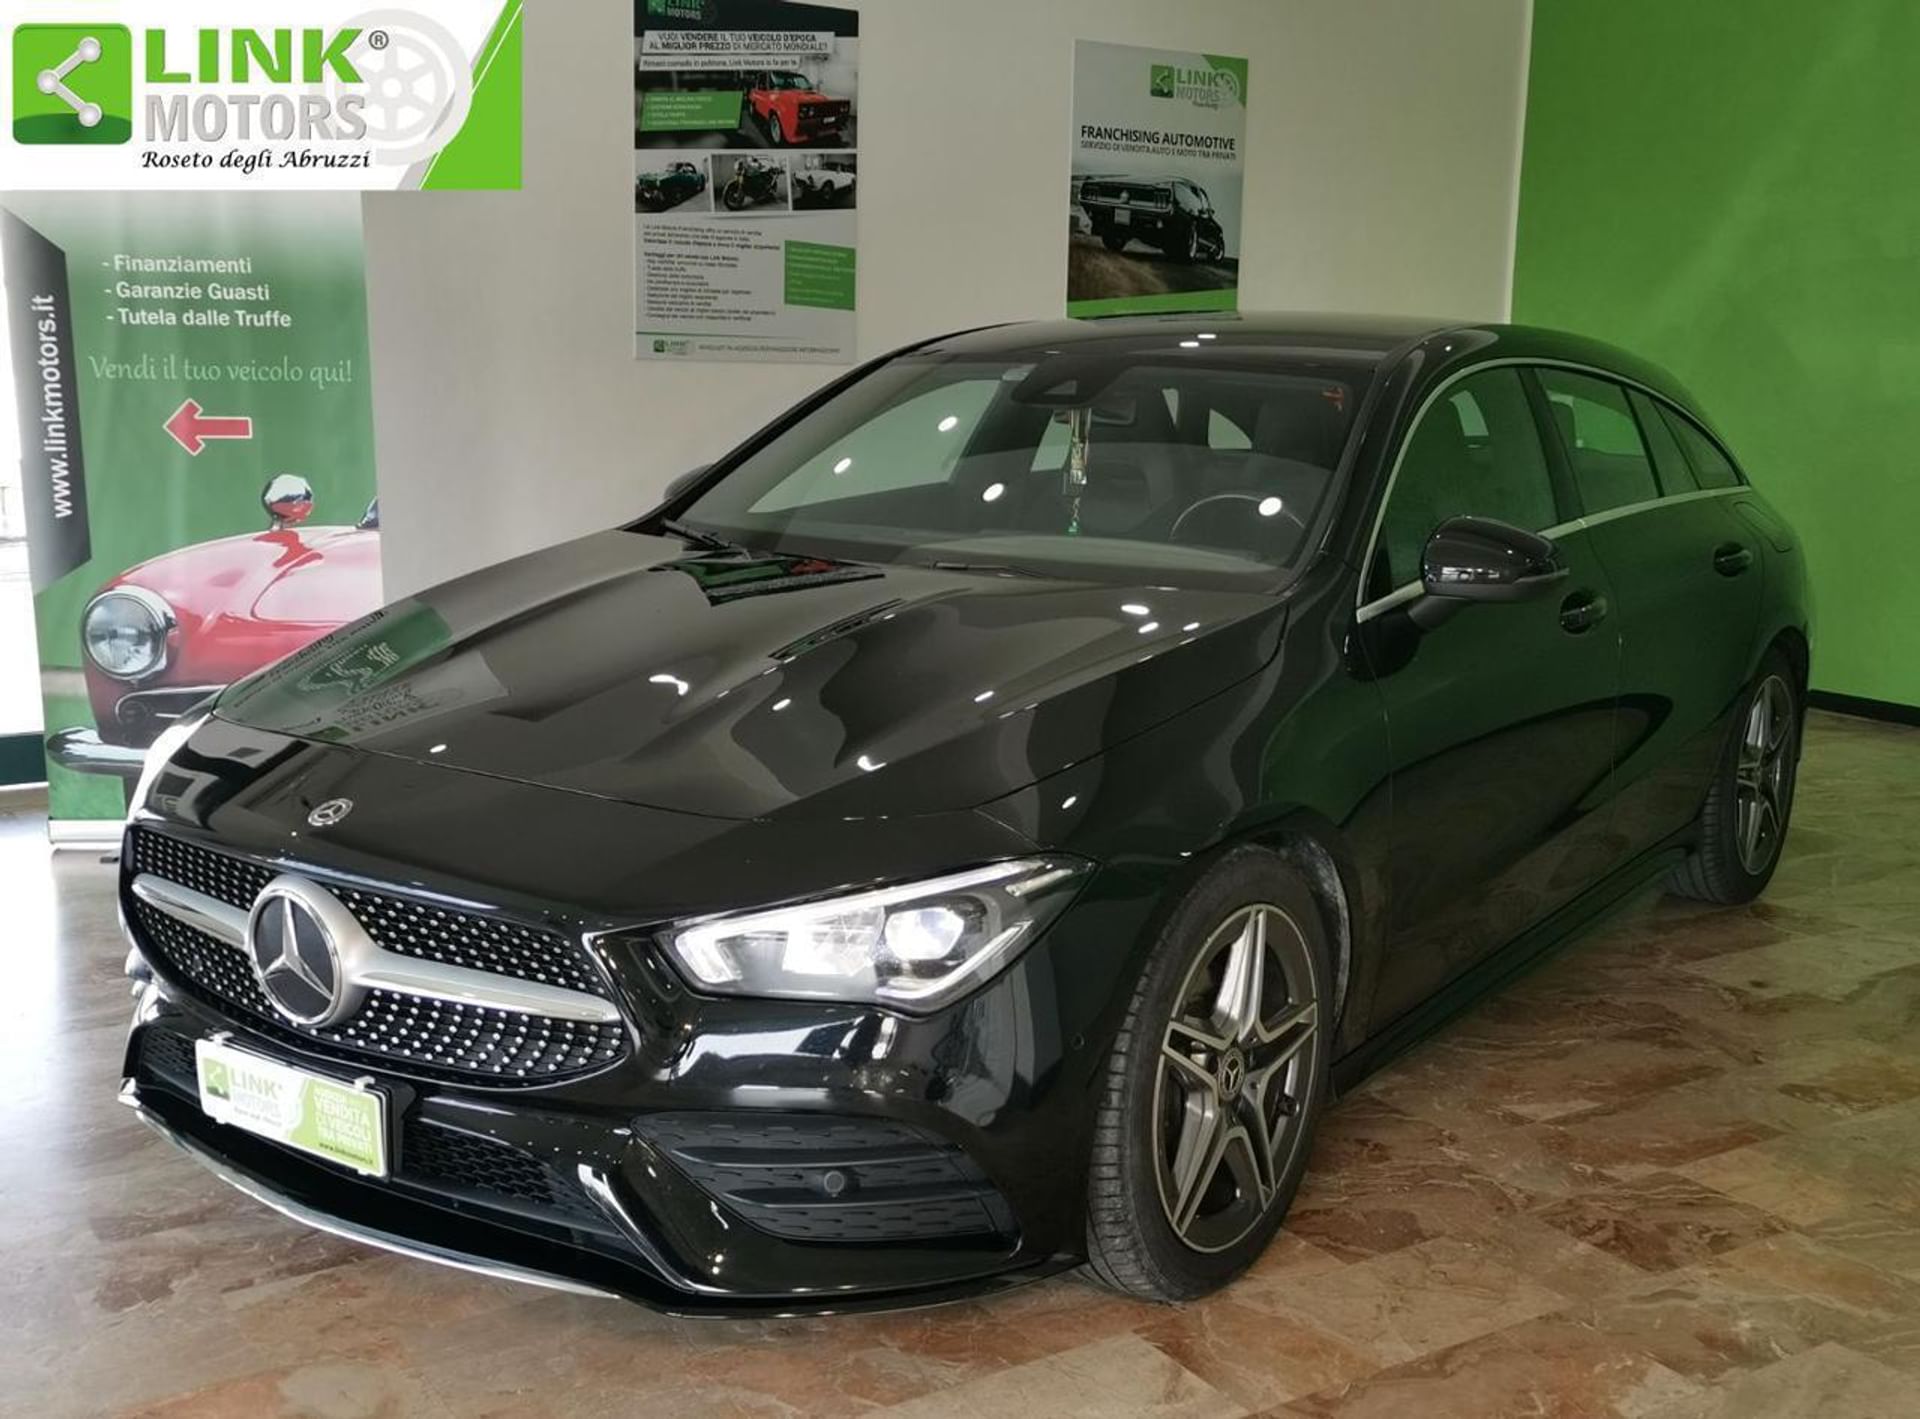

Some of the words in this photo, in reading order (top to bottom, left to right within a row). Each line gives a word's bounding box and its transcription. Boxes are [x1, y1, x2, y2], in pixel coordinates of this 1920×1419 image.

[1176, 68, 1219, 87] LINK
[1176, 86, 1220, 102] MOTORS
[1081, 125, 1160, 144] FRANCHISING
[1162, 132, 1236, 150] AUTOMOTIVE
[113, 254, 252, 274] Finanziamenti
[116, 281, 203, 300] Garanzie
[207, 282, 270, 302] Guasti
[117, 308, 177, 326] Tutela
[182, 309, 230, 326] dalle
[234, 309, 293, 327] Truffe
[88, 354, 157, 381] Vendi
[163, 354, 178, 381] il
[183, 360, 226, 382] tuo
[227, 356, 303, 383] veicolo
[309, 359, 353, 391] qui!
[31, 294, 73, 519] www.linkmotors.it
[230, 1068, 279, 1101] LINK
